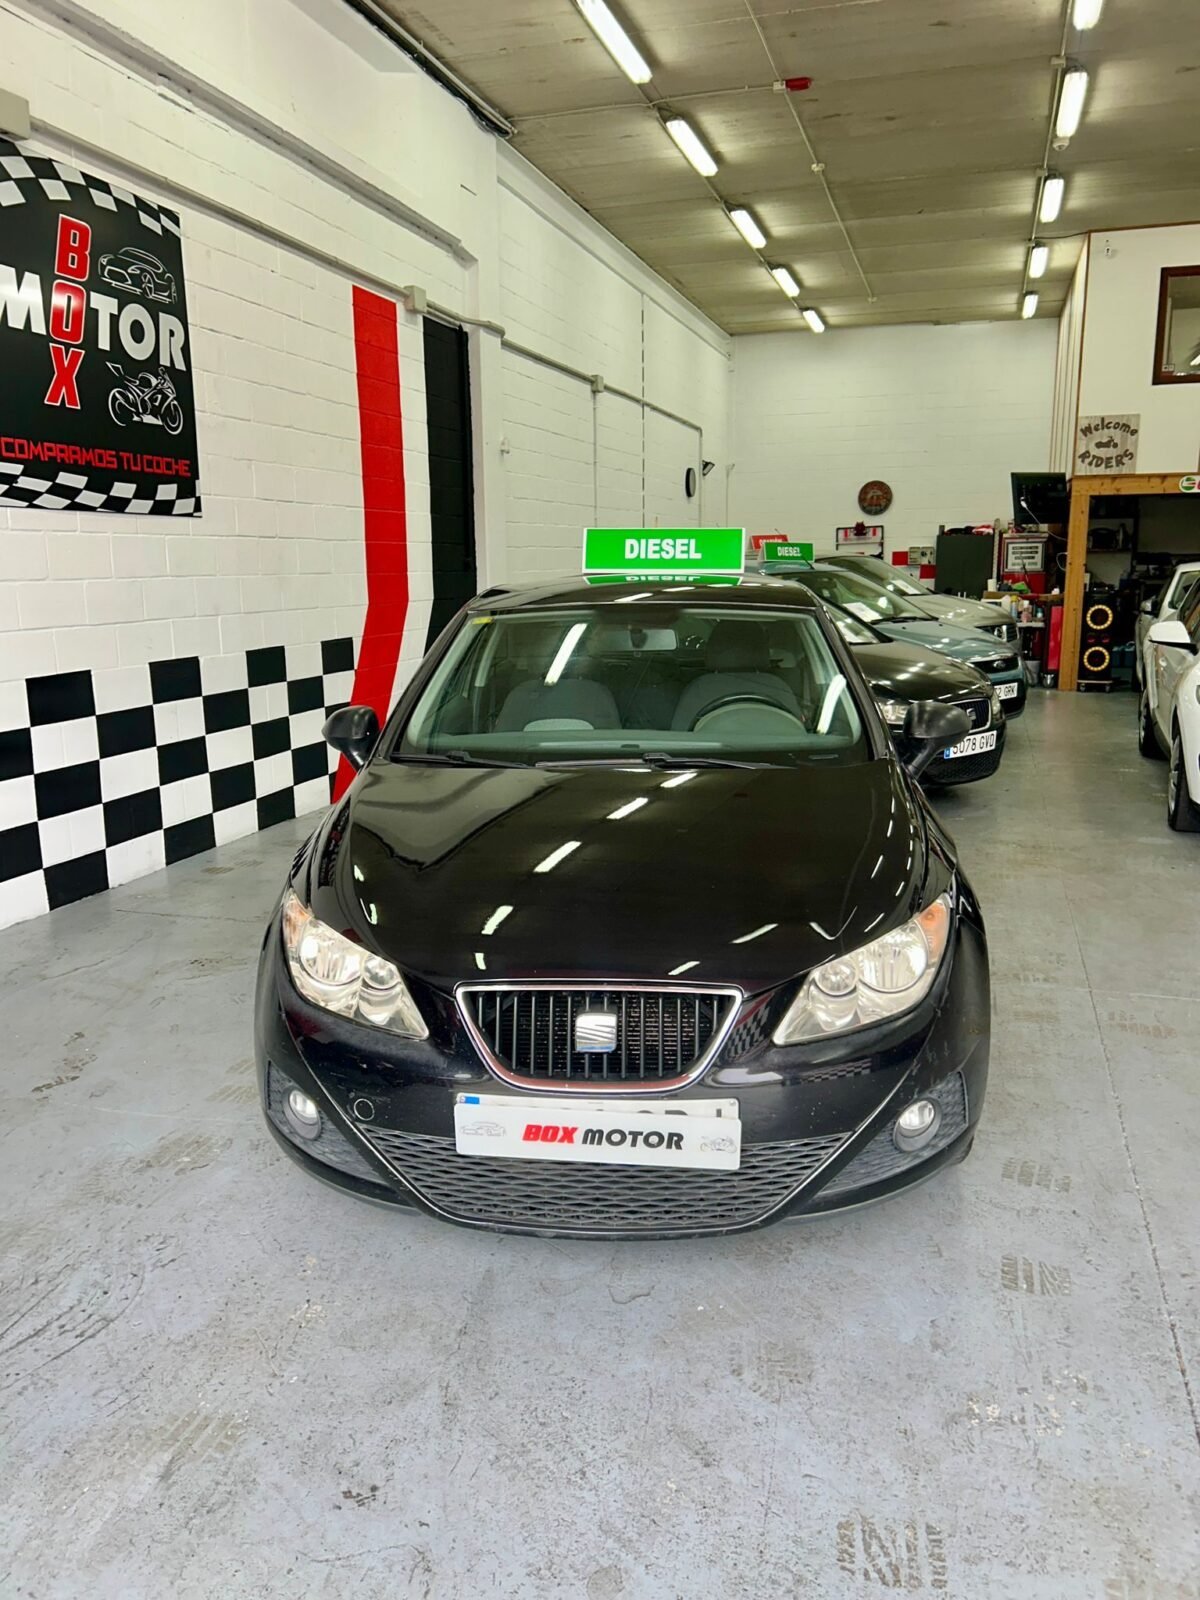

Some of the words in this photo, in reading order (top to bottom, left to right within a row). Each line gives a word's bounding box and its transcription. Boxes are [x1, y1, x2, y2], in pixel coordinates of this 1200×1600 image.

[44, 213, 92, 410] BOX
[1079, 417, 1139, 438] Welcome
[0, 437, 118, 469] COMPRAMOS
[119, 452, 141, 472] TU
[143, 455, 192, 477] COCHE
[1078, 449, 1135, 469] RIDERS
[624, 538, 702, 560] DIESEL
[777, 546, 802, 557] DIESEL
[979, 733, 995, 749] GVD
[522, 1123, 579, 1145] BOX
[581, 1127, 685, 1151] MOTOR
